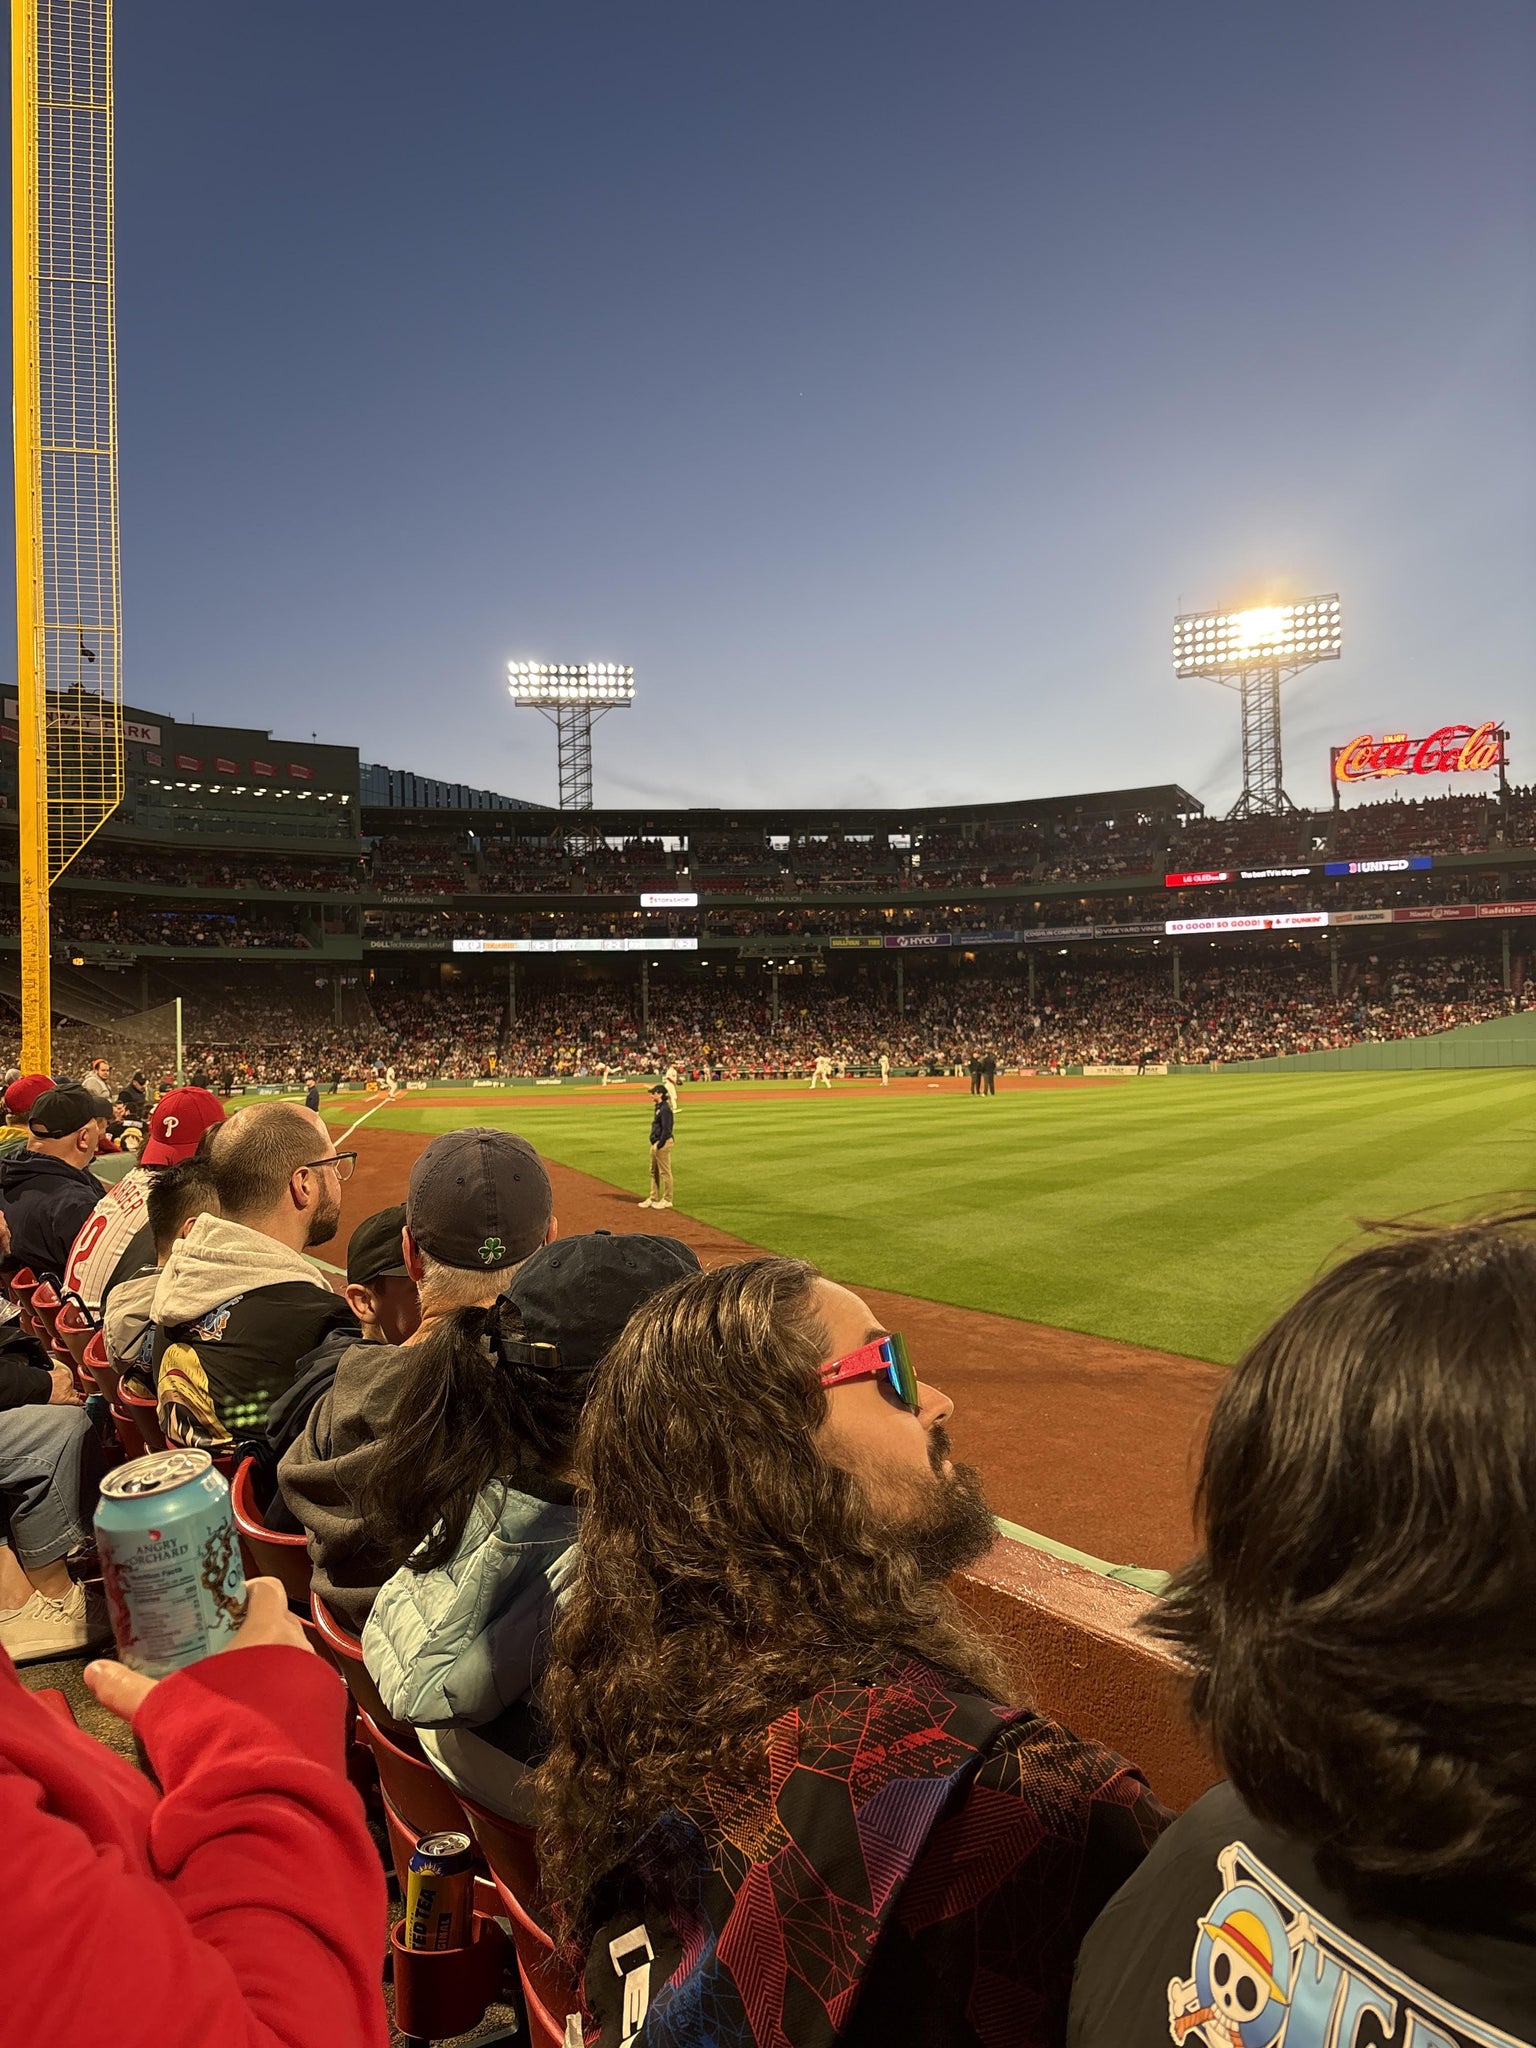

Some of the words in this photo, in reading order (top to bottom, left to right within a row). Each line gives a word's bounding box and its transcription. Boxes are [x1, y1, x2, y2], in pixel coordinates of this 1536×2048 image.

[104, 721, 152, 740] PARK
[1384, 734, 1406, 743] ENJOY
[1361, 859, 1409, 873] UNITED
[1480, 905, 1521, 915] Safelite
[1103, 926, 1140, 935] VINEYARD
[1140, 924, 1164, 932] VINES
[1185, 922, 1214, 930] GOOD!
[1216, 921, 1228, 929] SO
[1231, 920, 1260, 928] GOOD!
[429, 941, 445, 949] Level
[910, 936, 938, 946] HYCU
[163, 1116, 179, 1137] P
[136, 1538, 178, 1555] ANGRY
[126, 1544, 189, 1566] ORCHARD
[414, 1888, 437, 1920] TEA
